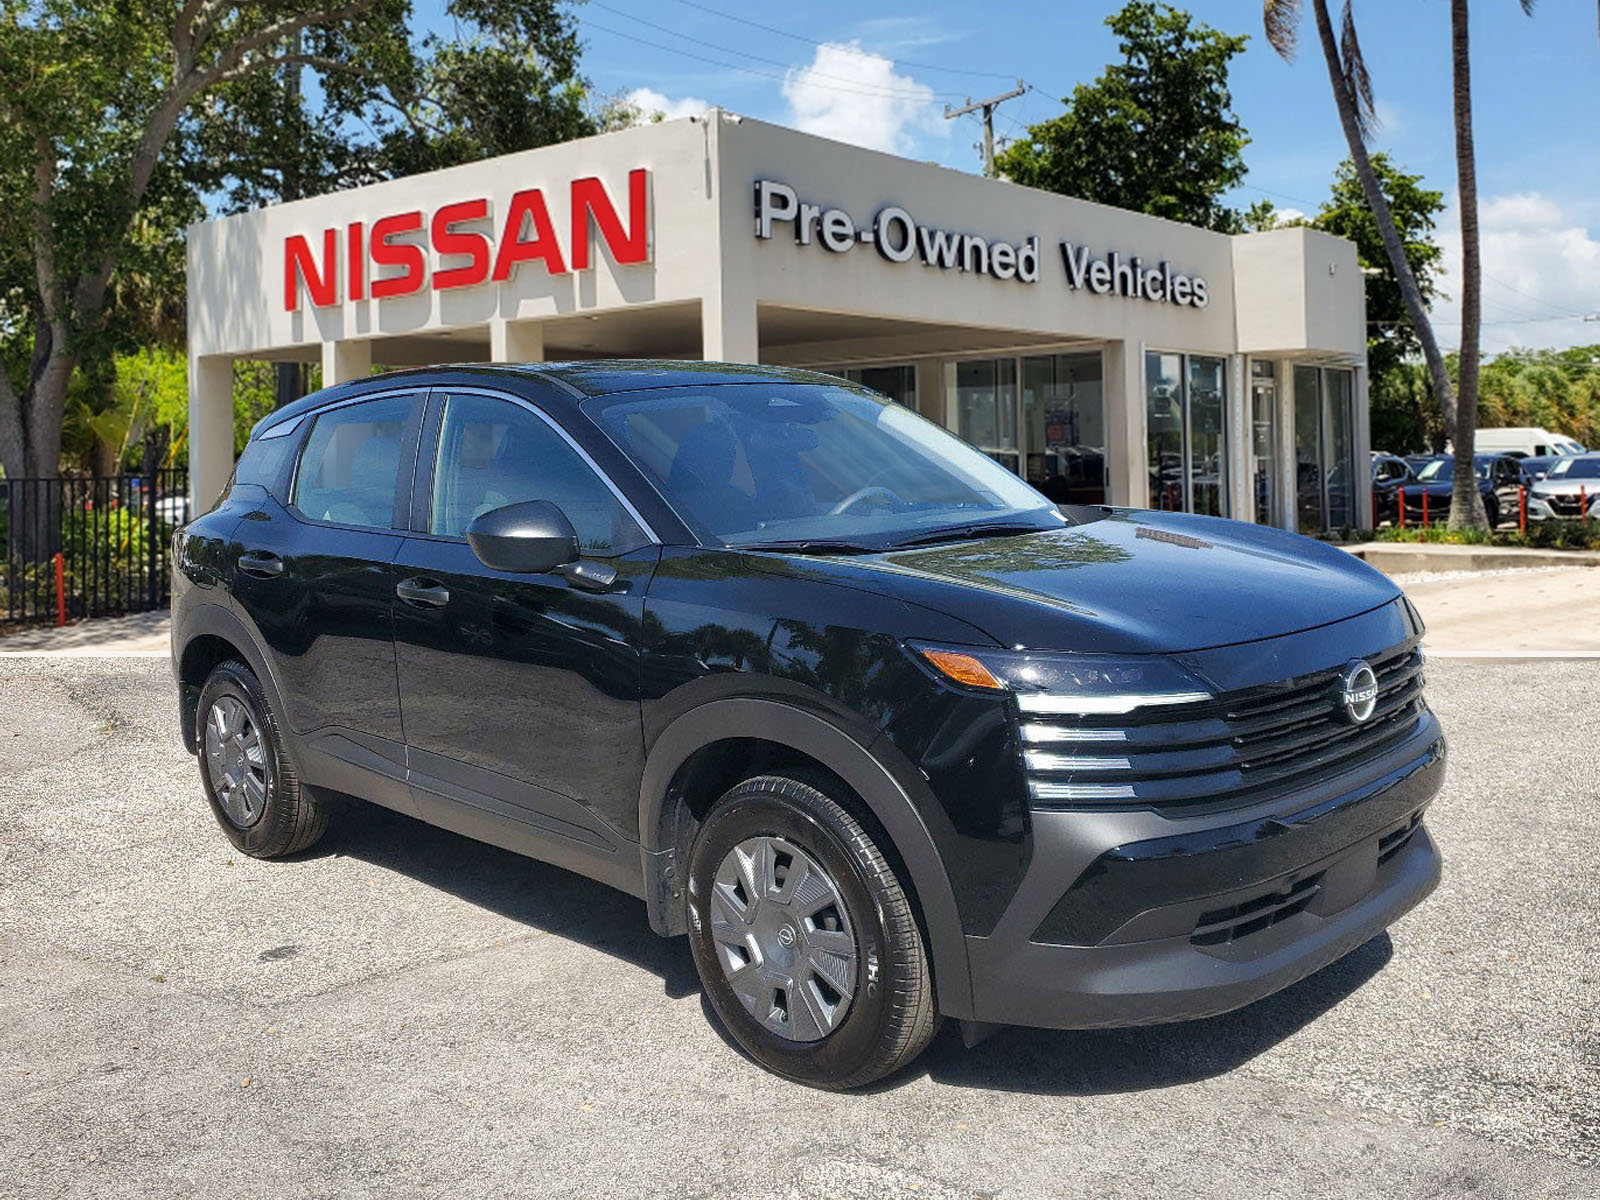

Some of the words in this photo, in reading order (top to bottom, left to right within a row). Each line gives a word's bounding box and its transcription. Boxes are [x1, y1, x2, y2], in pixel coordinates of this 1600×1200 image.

[285, 168, 647, 312] NISSAN
[754, 180, 1040, 283] Pre-Owned
[1060, 242, 1208, 308] Vehicles
